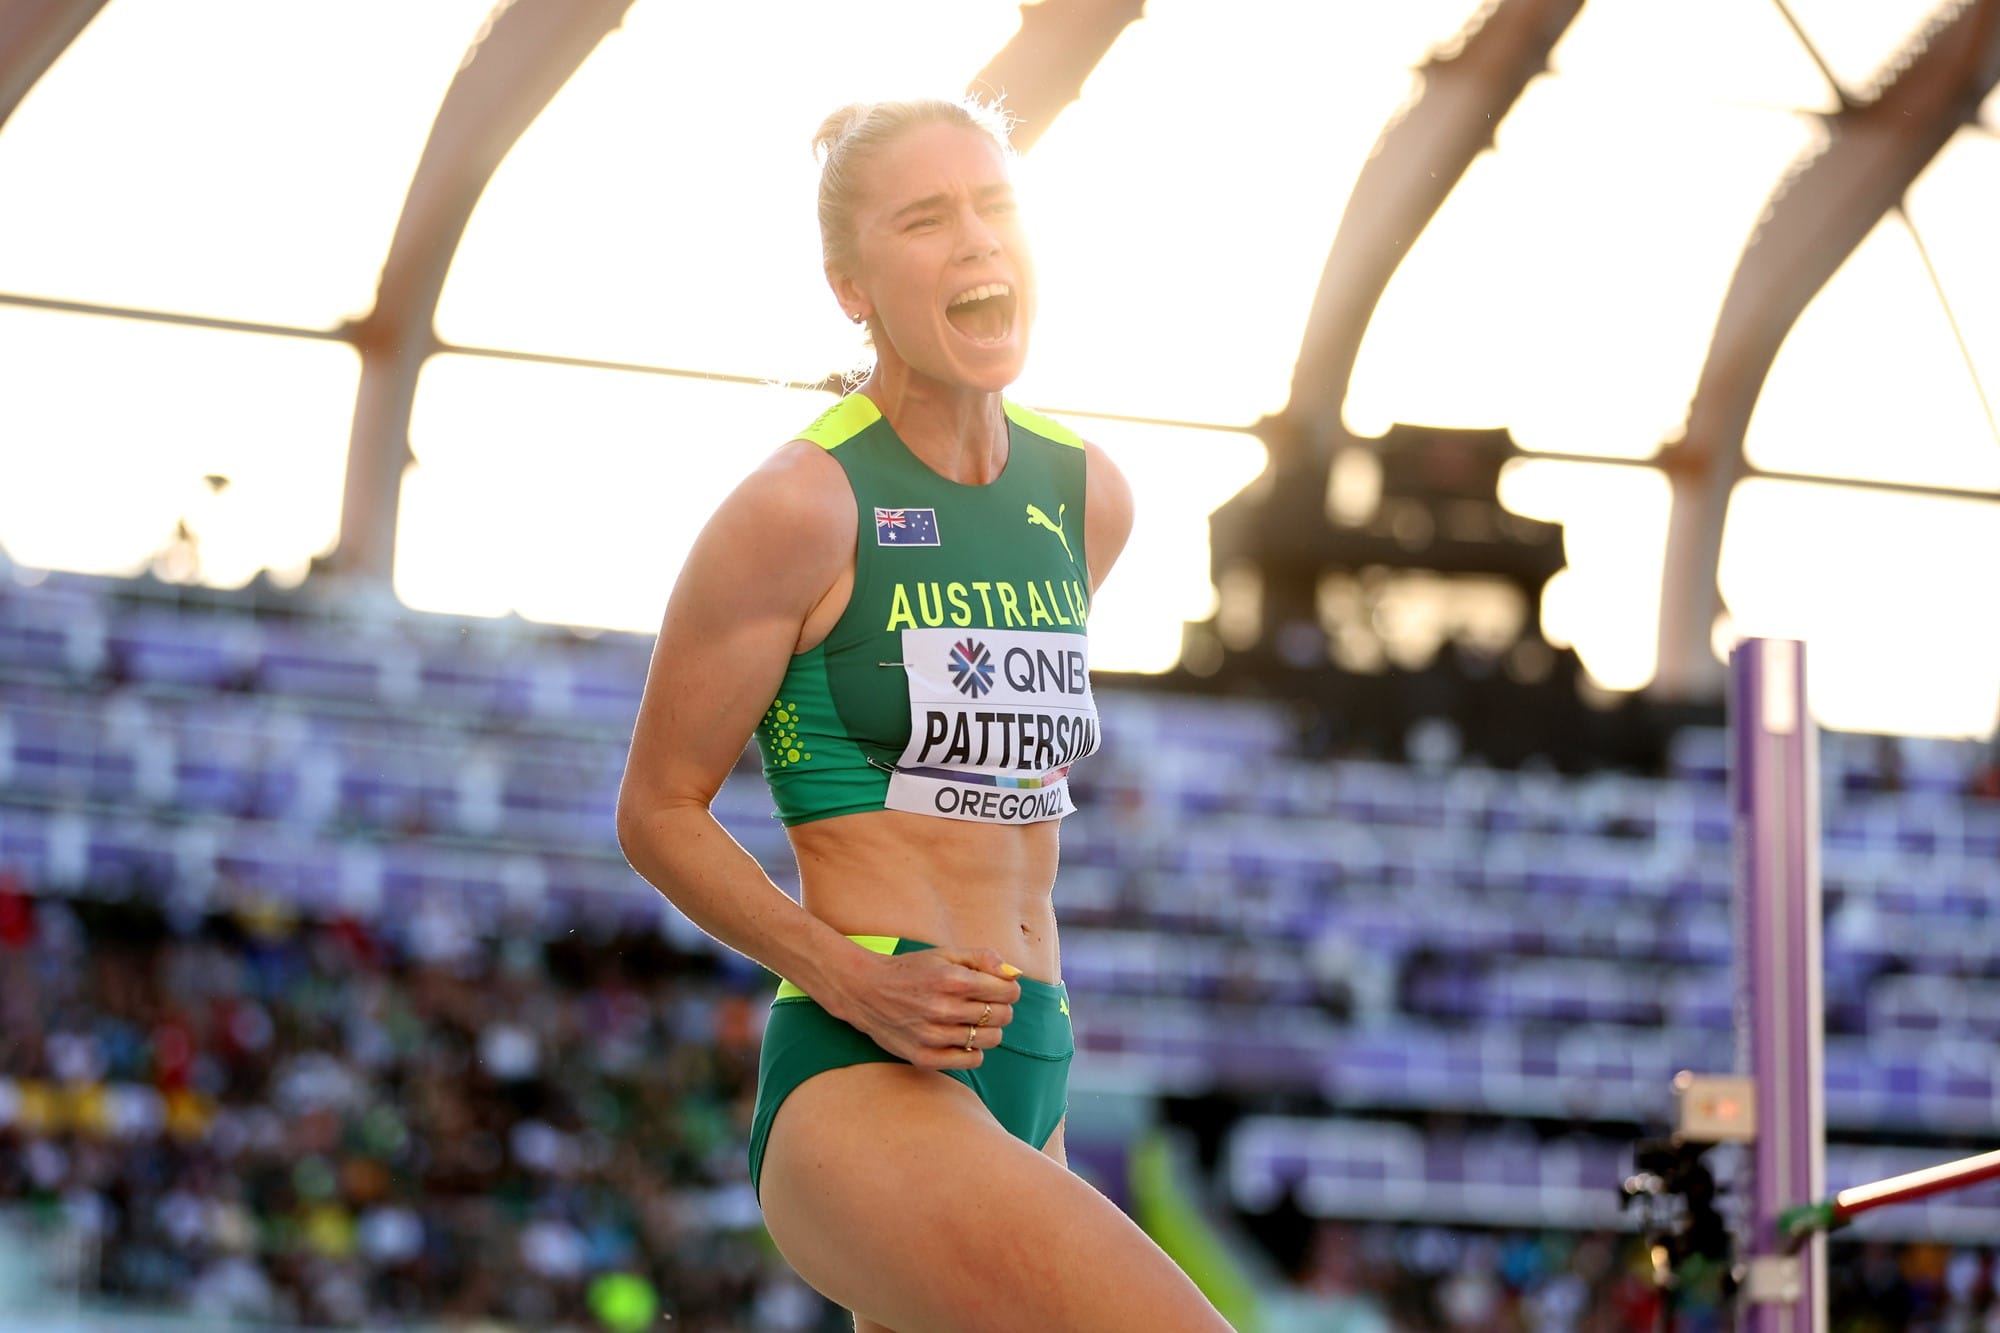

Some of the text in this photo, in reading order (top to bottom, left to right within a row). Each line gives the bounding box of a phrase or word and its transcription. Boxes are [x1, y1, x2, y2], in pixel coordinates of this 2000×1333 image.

[886, 580, 1087, 631] AUSTRALIA
[1004, 647, 1085, 694] QNB
[917, 711, 1095, 770] PATTERSON
[935, 787, 1063, 820] OREGON22
